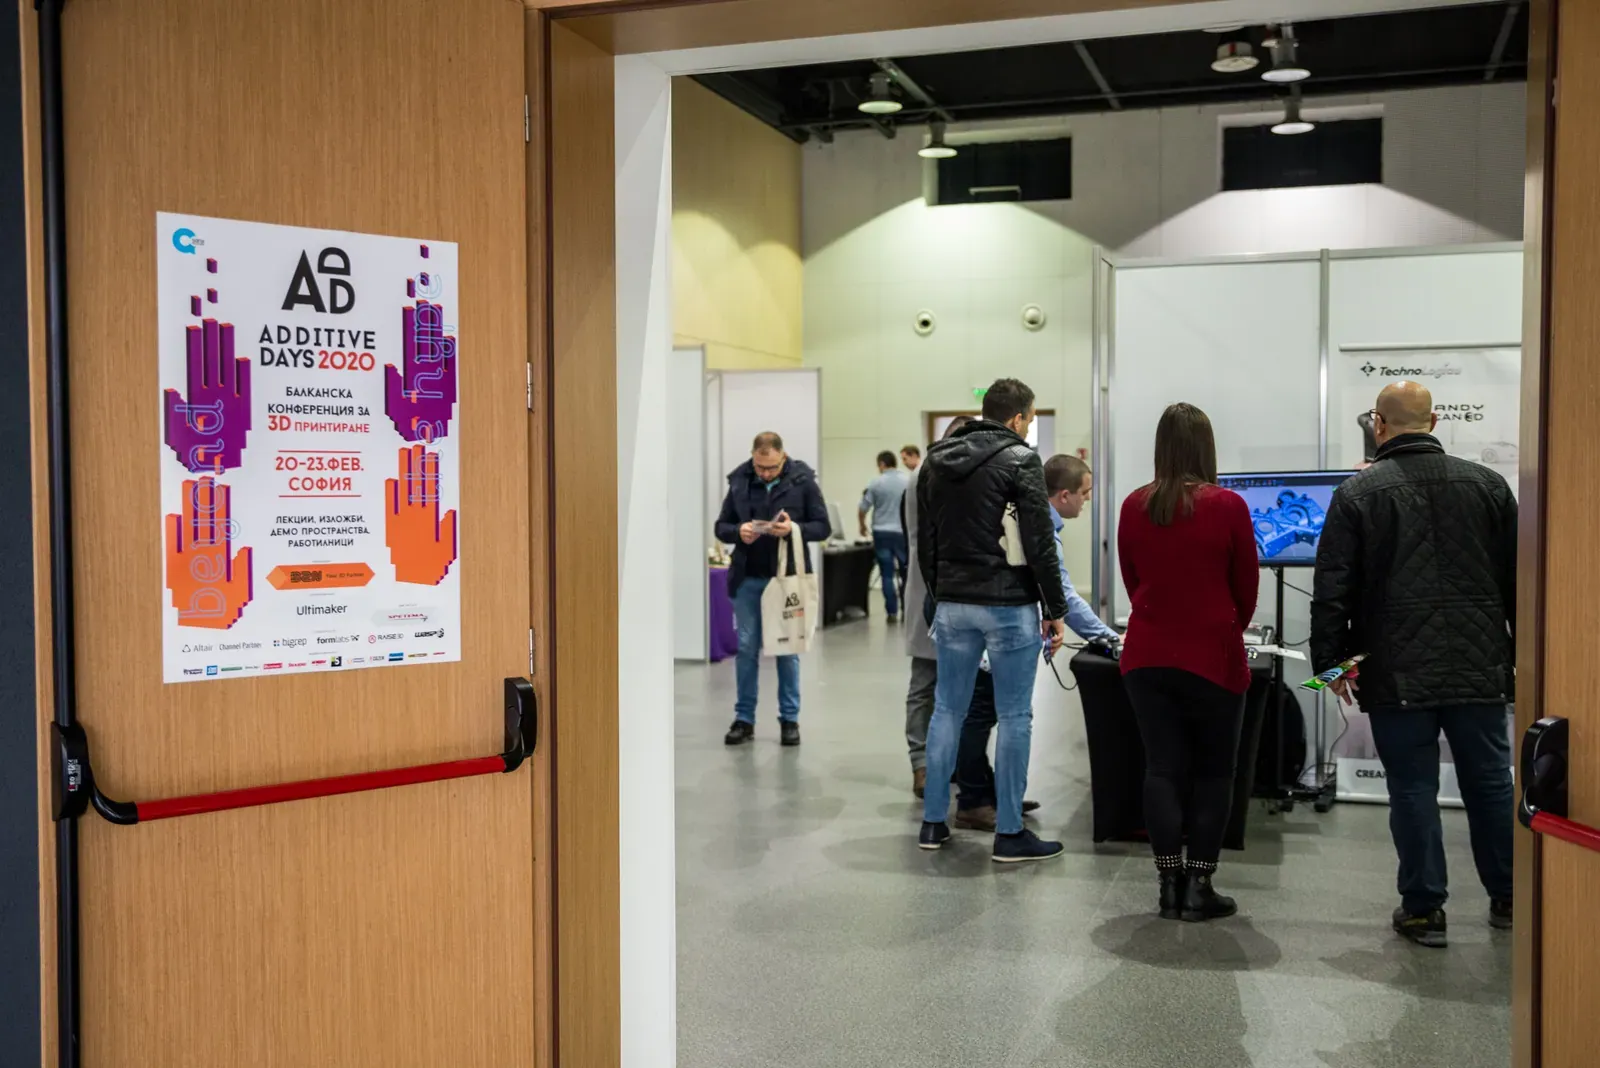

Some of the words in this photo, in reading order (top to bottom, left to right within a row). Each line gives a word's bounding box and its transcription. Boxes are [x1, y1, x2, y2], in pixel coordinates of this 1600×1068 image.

[259, 324, 376, 350] ADDITIVE
[260, 346, 315, 369] DAYS
[318, 350, 376, 371] 2020
[286, 386, 353, 399] БАЛКАНСКА
[267, 403, 354, 417] КОНФЕРЕНЦИЯ
[357, 406, 370, 417] ЗА
[268, 415, 292, 431] 3D
[294, 421, 370, 433] ПРИНТИРАНЕ
[288, 477, 352, 491] СОФИЯ
[175, 399, 242, 619] beyond
[270, 527, 298, 537] ДЕМО
[288, 538, 354, 547] РАБОТИЛНИЦИ
[296, 604, 348, 616] Ultimaker
[219, 643, 241, 651] Channel
[242, 641, 262, 650] Partner
[317, 636, 350, 644] formlabs
[193, 644, 214, 652] Altair
[1355, 769, 1387, 778] CREA
